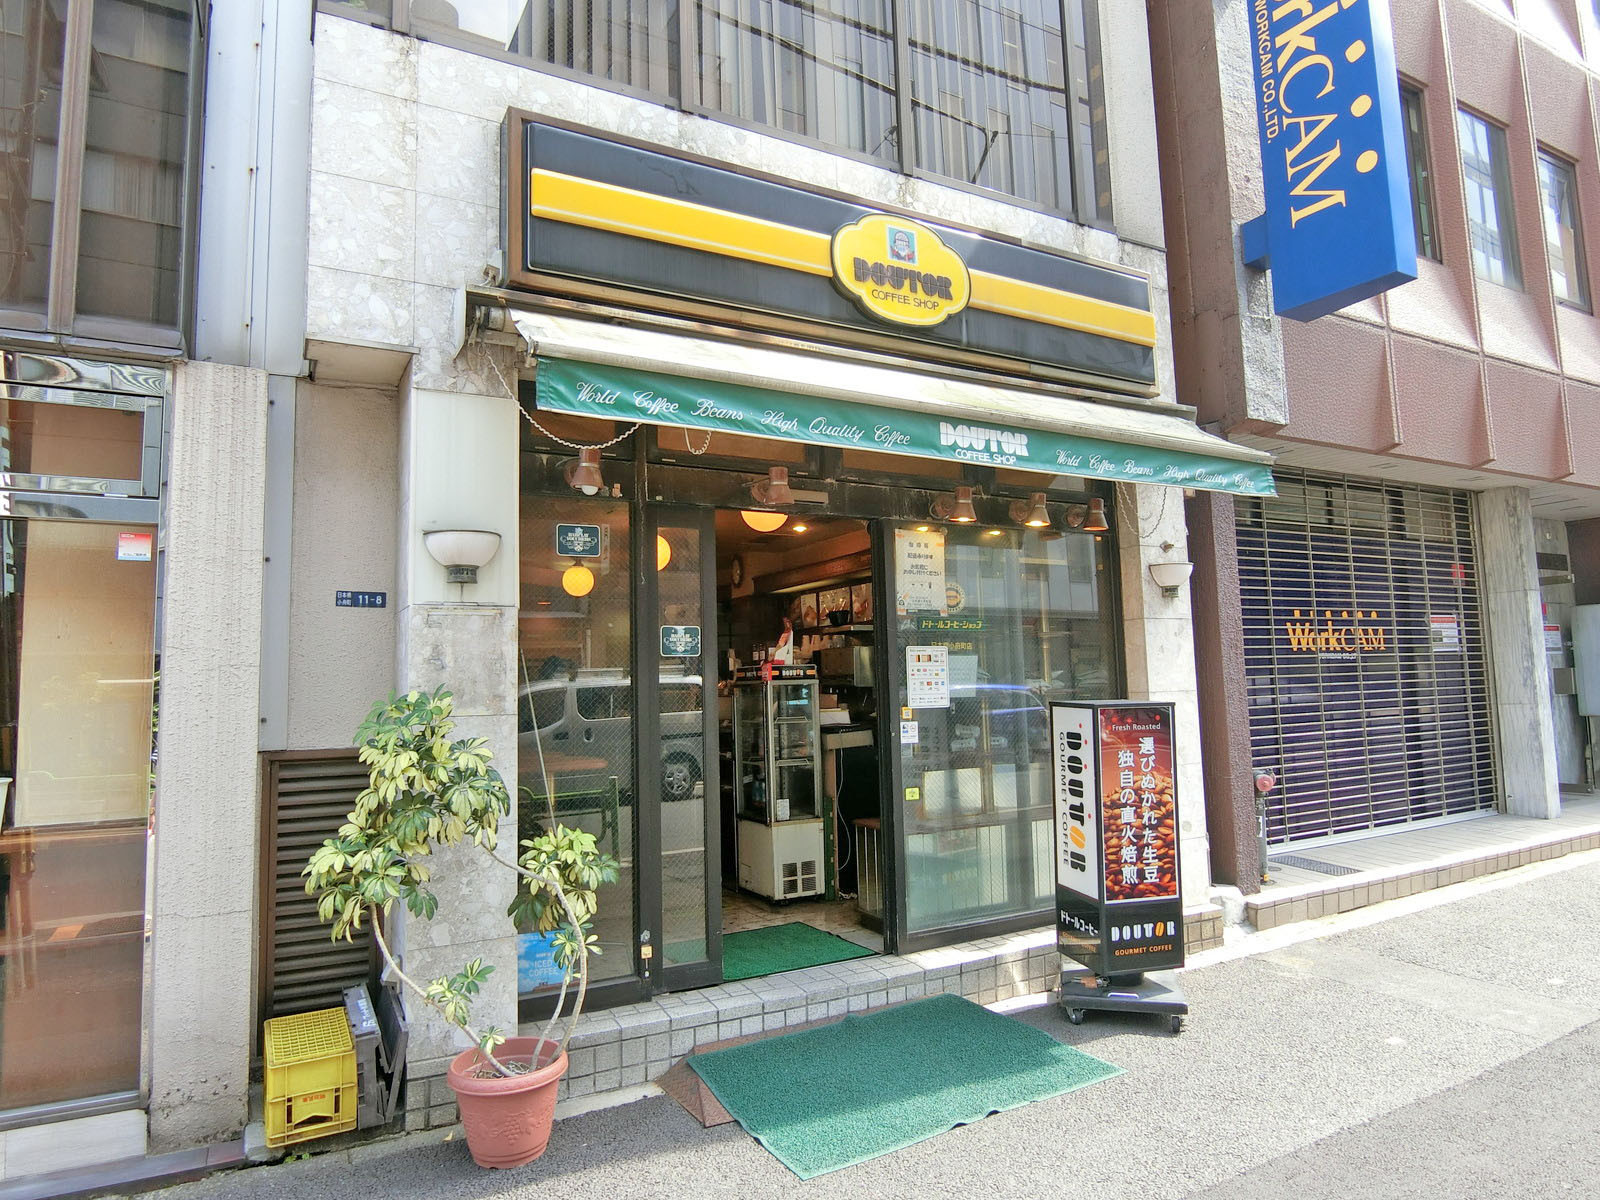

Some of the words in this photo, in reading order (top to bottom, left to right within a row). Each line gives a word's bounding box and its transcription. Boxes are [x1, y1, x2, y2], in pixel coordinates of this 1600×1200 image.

[1254, 0, 1273, 78] WORKCAM
[1271, 0, 1346, 229] rkCAM
[853, 256, 953, 301] DOUTOR
[872, 289, 910, 304] COFFEE
[913, 298, 940, 310] SHOP
[576, 382, 621, 404] World
[633, 390, 680, 414] Coffee
[690, 398, 744, 421] Beans
[760, 410, 799, 432] High
[809, 416, 864, 440] Quality
[874, 424, 912, 448] Coffee
[939, 422, 1029, 456] DOUTOR
[955, 448, 991, 462] COFFEE
[993, 454, 1016, 465] SHOP
[1056, 450, 1082, 466] World
[1089, 454, 1116, 472] Coffee
[1122, 460, 1154, 476] Beans
[1163, 464, 1189, 480] High
[1194, 468, 1228, 486] Quality
[1232, 473, 1256, 489] Coffee
[358, 594, 382, 604] 11-8
[922, 620, 982, 629] ドトールコーヒーショップ
[1286, 620, 1386, 652] WorkCAM
[1132, 722, 1161, 731] Roasted
[1060, 732, 1068, 804] GOURMET
[1066, 731, 1086, 873] DOUTOR
[1117, 749, 1139, 885] 独自の直火焙煎
[1138, 736, 1160, 884] 選びぬかれた生豆
[1062, 813, 1070, 866] COFFEE
[1060, 910, 1099, 936] ドトールコーヒー
[1111, 920, 1175, 942] DOUTOR
[534, 960, 552, 968] ICED
[1114, 946, 1147, 956] GOURMET
[1149, 944, 1172, 952] COFFEE
[528, 968, 558, 977] COFFEE
